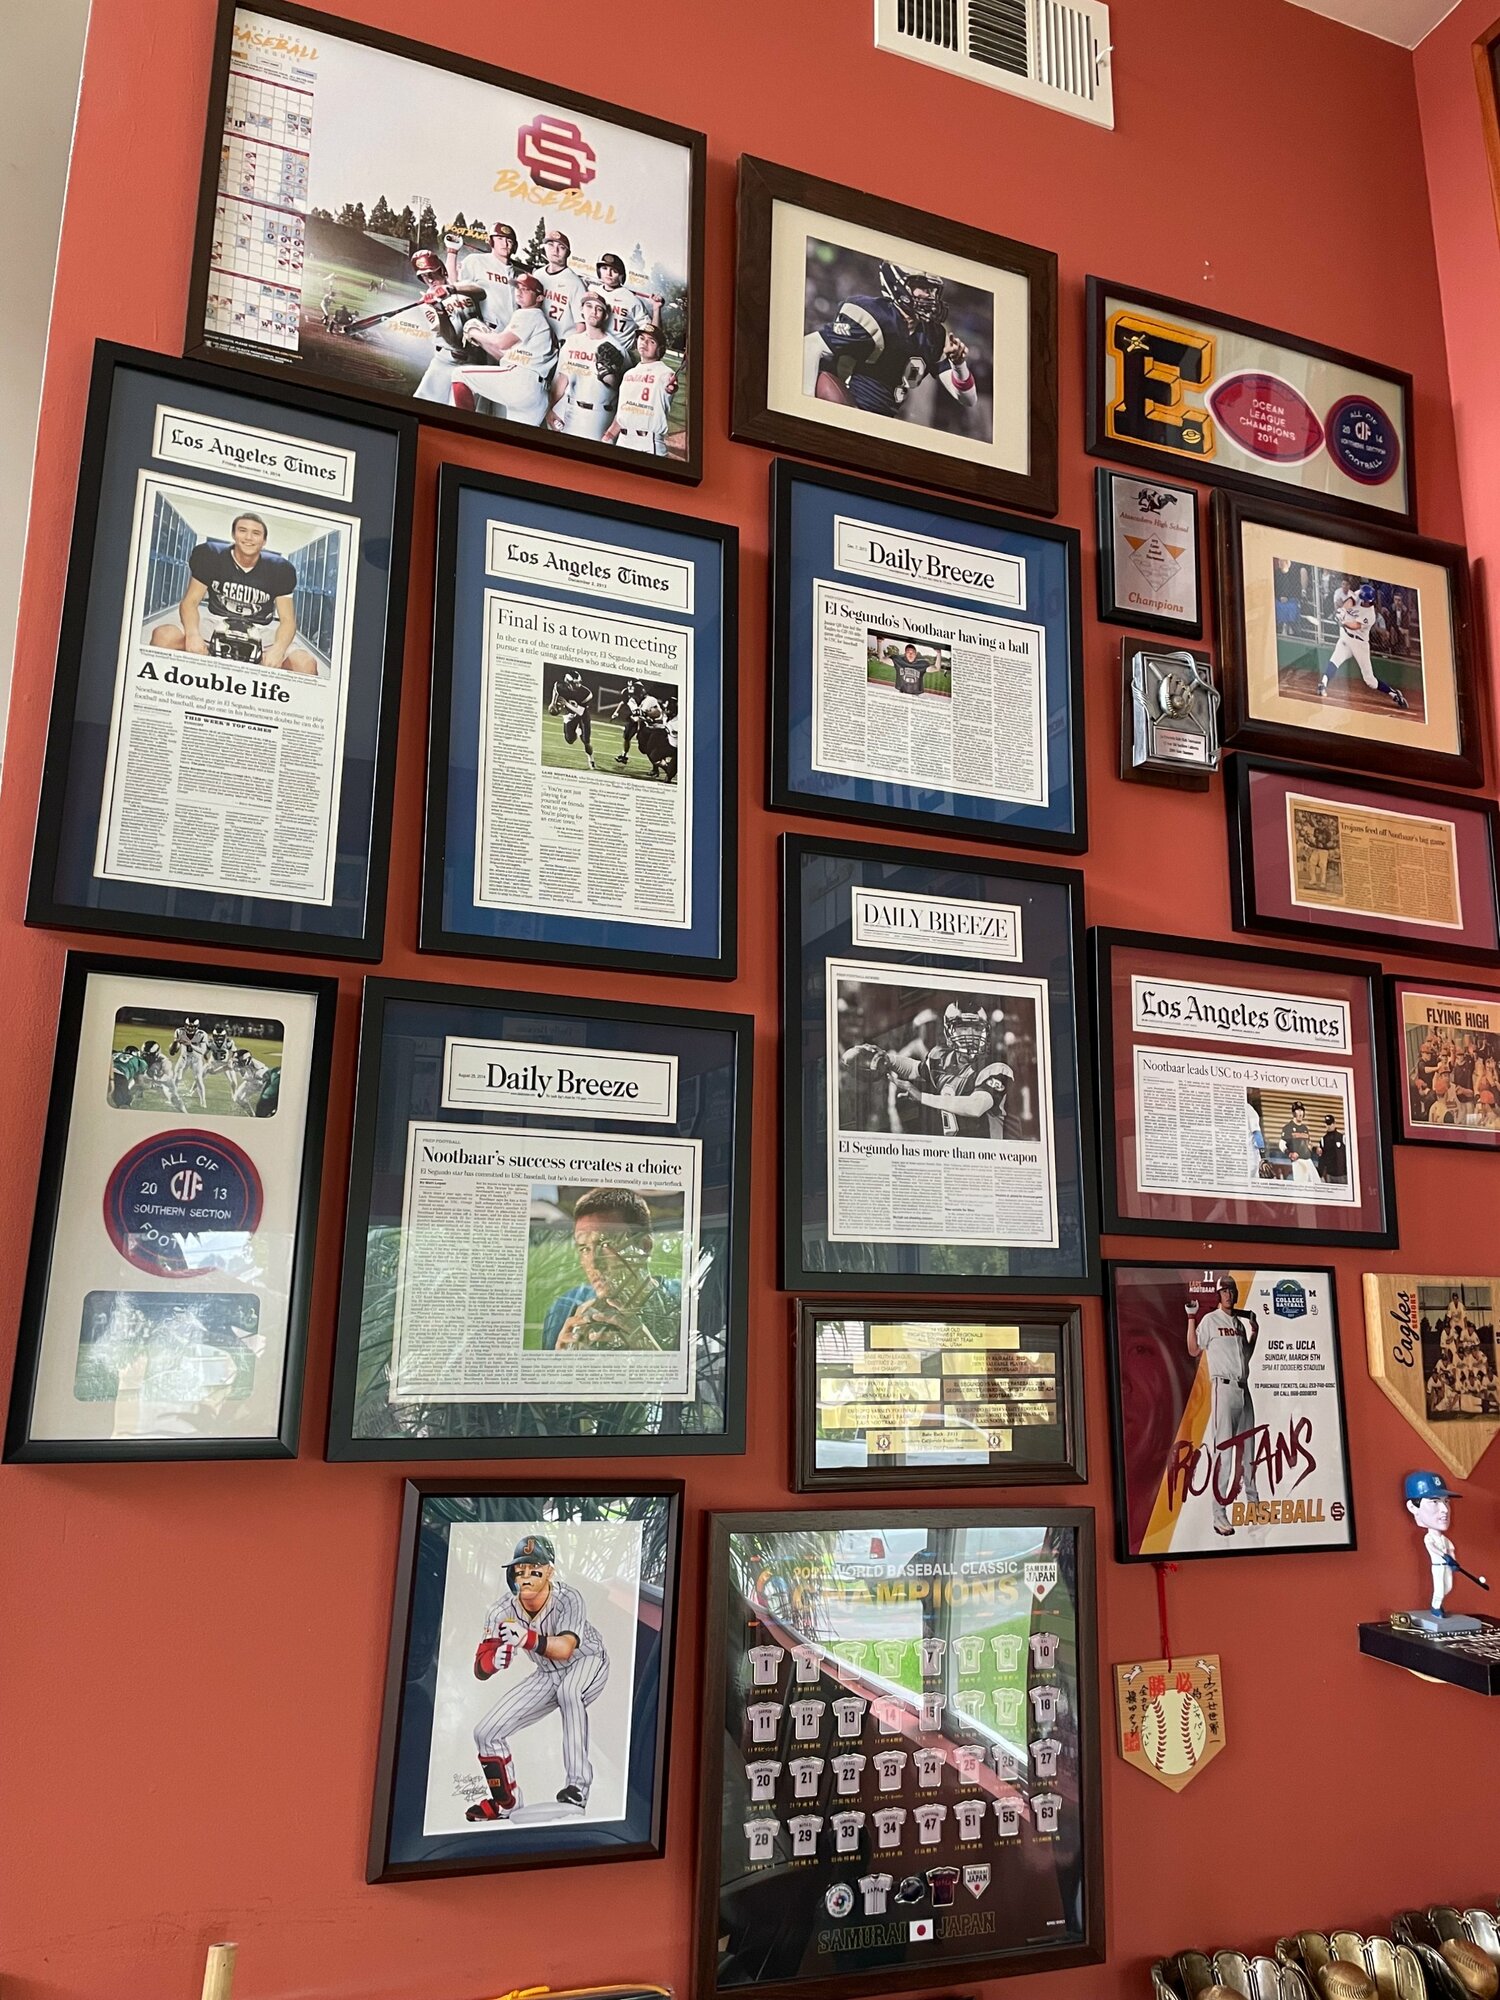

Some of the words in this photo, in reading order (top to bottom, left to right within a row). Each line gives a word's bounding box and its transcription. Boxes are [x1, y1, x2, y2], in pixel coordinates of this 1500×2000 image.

[493, 168, 618, 225] BASEBALL
[549, 306, 564, 321] 27
[614, 318, 626, 332] 17
[641, 388, 650, 401] 8
[1106, 310, 1216, 462] E
[1252, 399, 1284, 415] OCEAN
[1250, 408, 1286, 428] LEAGUE
[1240, 416, 1296, 440] CHAMPIONS
[1354, 422, 1371, 440] CIF
[1258, 432, 1278, 444] 2014
[171, 428, 203, 449] Los
[207, 437, 276, 466] Angeles
[283, 454, 336, 480] Times
[1345, 450, 1382, 470] FOOTBALL
[1154, 518, 1168, 528] High
[1170, 522, 1189, 532] School
[507, 543, 538, 564] Los
[542, 551, 611, 579] Angeles
[617, 566, 669, 591] Times
[869, 540, 923, 577] Daily
[926, 554, 995, 588] Breeze
[222, 582, 272, 604] SEGUNDO
[1128, 592, 1184, 613] Champions
[498, 607, 537, 631] Final
[543, 616, 555, 633] is
[558, 624, 567, 636] a
[571, 625, 610, 644] town
[614, 634, 677, 659] meeting
[825, 600, 836, 615] El
[840, 604, 899, 628] Segundo's
[902, 617, 956, 639] Nootbaar
[958, 628, 996, 651] having
[998, 641, 1005, 650] a
[1008, 638, 1028, 654] ball
[495, 642, 518, 652] pursue
[525, 647, 539, 656] title
[539, 650, 557, 660] using
[558, 652, 584, 663] athletes
[584, 657, 599, 666] who
[600, 661, 617, 669] stuck
[617, 662, 634, 672] close
[643, 666, 662, 677] home
[496, 632, 504, 640] In
[504, 633, 516, 642] the
[529, 639, 537, 649] of
[538, 639, 549, 648] the
[550, 643, 575, 655] transfer
[576, 647, 598, 658] player,
[599, 650, 606, 658] El
[607, 652, 635, 663] Segundo
[636, 658, 648, 668] and
[649, 659, 678, 670] Nordhoff
[136, 661, 159, 680] A
[163, 665, 246, 695] double
[250, 679, 290, 702] life
[1341, 822, 1364, 832] Trojans
[1364, 826, 1378, 834] feed
[864, 903, 924, 929] DAILY
[930, 911, 1008, 938] BREEZE
[1142, 991, 1182, 1018] Los
[1184, 996, 1269, 1029] Angeles
[1273, 1007, 1339, 1037] Times
[1426, 1008, 1462, 1026] FLYING
[1465, 1012, 1489, 1029] HIGH
[486, 1063, 553, 1098] Daily
[557, 1069, 639, 1098] Breeze
[1142, 1058, 1185, 1073] Nootbaar
[1186, 1062, 1209, 1076] leads
[1210, 1065, 1231, 1078] USC
[1232, 1070, 1242, 1079] to
[1243, 1069, 1258, 1081] 4-3
[1260, 1070, 1289, 1086] victory
[1290, 1077, 1309, 1086] over
[1310, 1075, 1338, 1088] UCLA
[422, 1146, 505, 1165] Nootbaar's
[508, 1156, 565, 1168] success
[569, 1158, 621, 1171] creates
[624, 1162, 633, 1172] a
[637, 1158, 681, 1174] choice
[838, 1140, 849, 1152] El
[852, 1141, 899, 1157] Segundo
[901, 1143, 920, 1156] has
[922, 1148, 949, 1157] more
[952, 1146, 975, 1159] than
[977, 1151, 996, 1160] one
[998, 1152, 1037, 1165] weapon
[160, 1153, 186, 1170] ALL
[196, 1156, 220, 1172] CIF
[140, 1182, 158, 1195] 20
[213, 1187, 227, 1200] 13
[170, 1170, 203, 1200] CIF
[133, 1204, 186, 1217] SOUTHERN
[190, 1208, 232, 1220] SECTION
[1203, 1271, 1214, 1282] 11
[1410, 1294, 1418, 1330] SENIORS
[1390, 1290, 1420, 1368] Eagles
[1268, 1340, 1284, 1350] USC
[1296, 1340, 1316, 1350] UCLA
[1231, 1498, 1325, 1526] BASEBALL
[834, 1563, 884, 1579] WORLD
[887, 1562, 958, 1578] BASEBALL
[960, 1560, 1018, 1575] CLASSIC
[1025, 1564, 1057, 1574] SAMURAI
[1026, 1571, 1056, 1584] JAPAN
[791, 1578, 1020, 1610] CHAMPIONS
[802, 1714, 813, 1726] 12
[844, 1711, 855, 1723] 13
[801, 1772, 812, 1784] 21
[843, 1768, 855, 1780] 22
[884, 1764, 897, 1776] 23
[757, 1774, 770, 1786] 20
[965, 1815, 976, 1827] 51
[1002, 1811, 1015, 1823] 55
[1041, 1806, 1054, 1818] 63
[798, 1830, 812, 1842] 29
[841, 1826, 854, 1838] 33
[884, 1822, 896, 1834] 34
[966, 1869, 989, 1877] SAMURAI
[966, 1873, 989, 1883] JAPAN
[866, 1886, 884, 1894] JAPAN
[817, 1922, 907, 1954] SAMURAI
[935, 1911, 996, 1939] JAPAN
